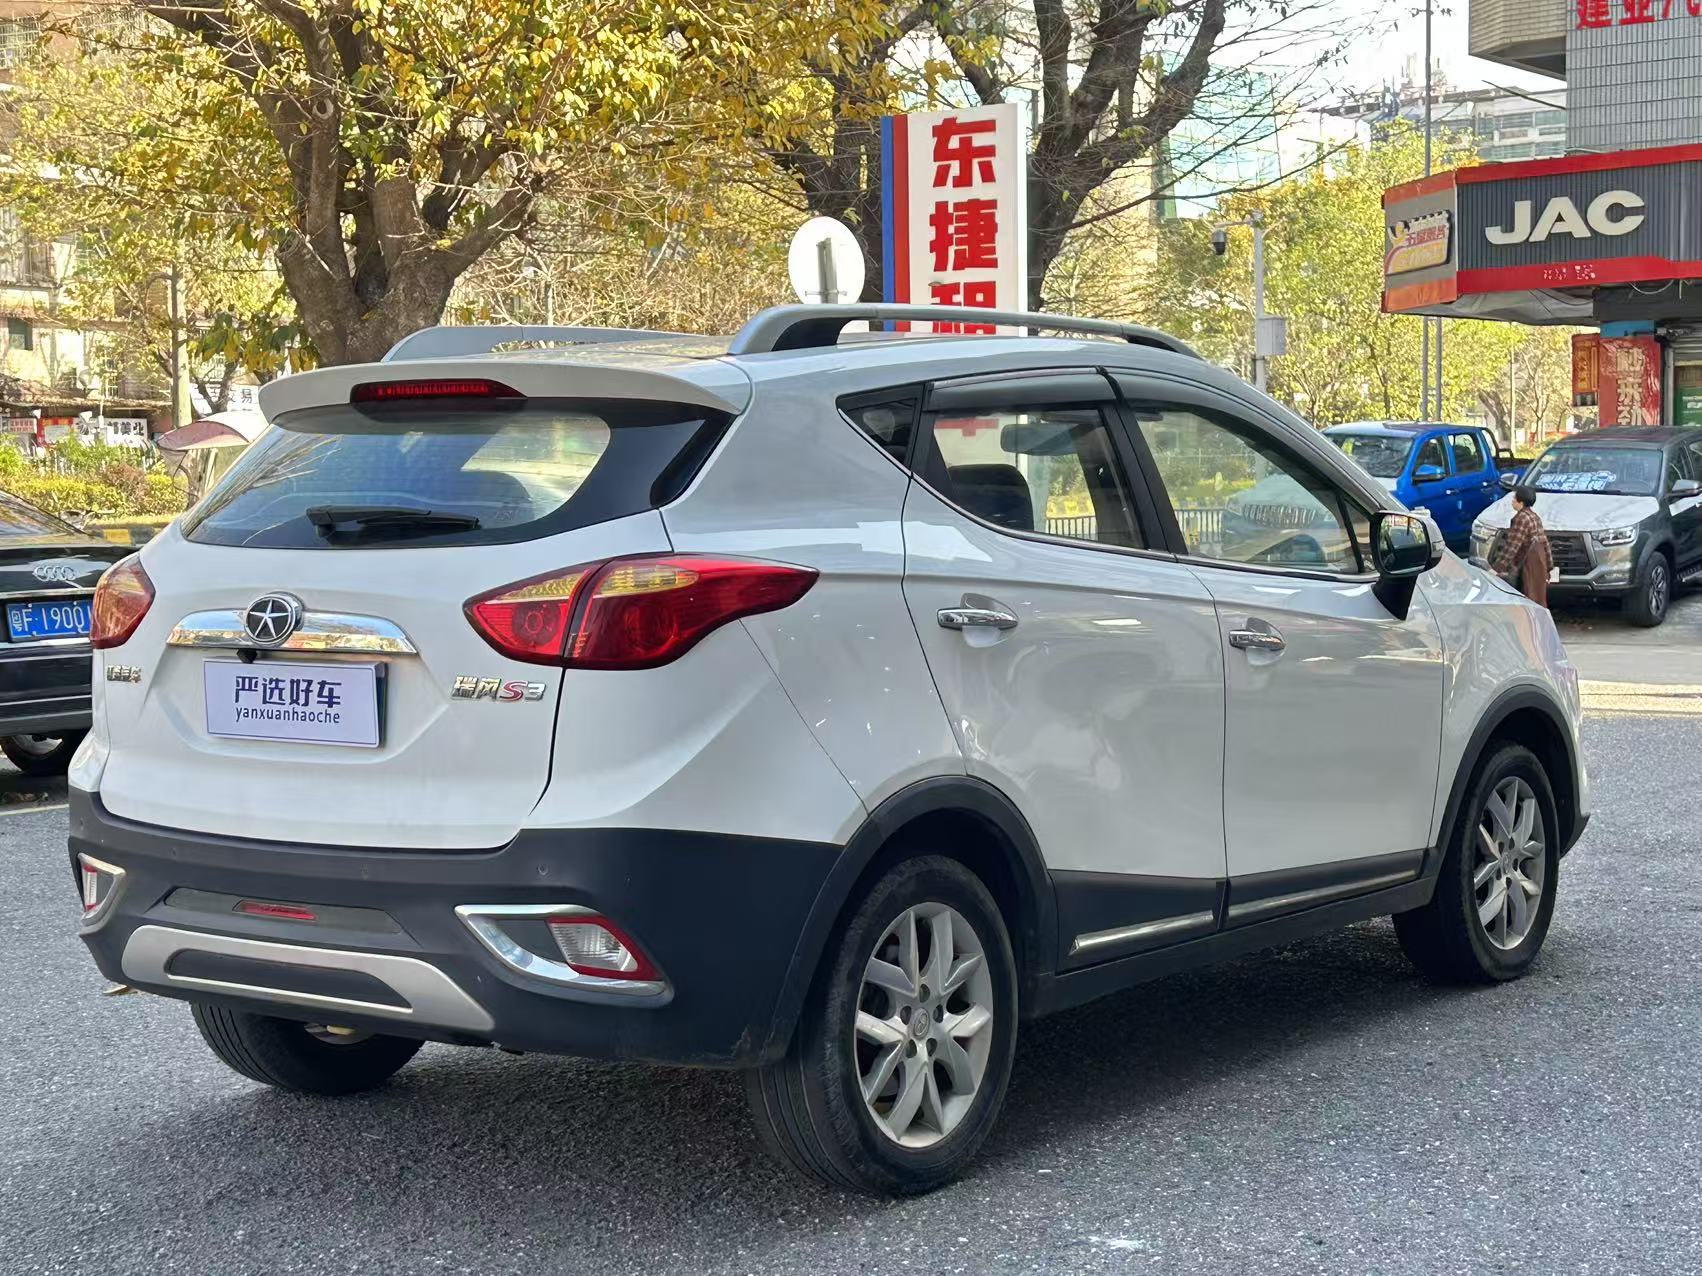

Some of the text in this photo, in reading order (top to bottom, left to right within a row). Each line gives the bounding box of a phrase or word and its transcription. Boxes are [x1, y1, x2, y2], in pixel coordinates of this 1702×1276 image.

[1485, 190, 1645, 245] JAC
[235, 675, 342, 708] 严选好车
[235, 706, 341, 724] yanxuanhaoche
